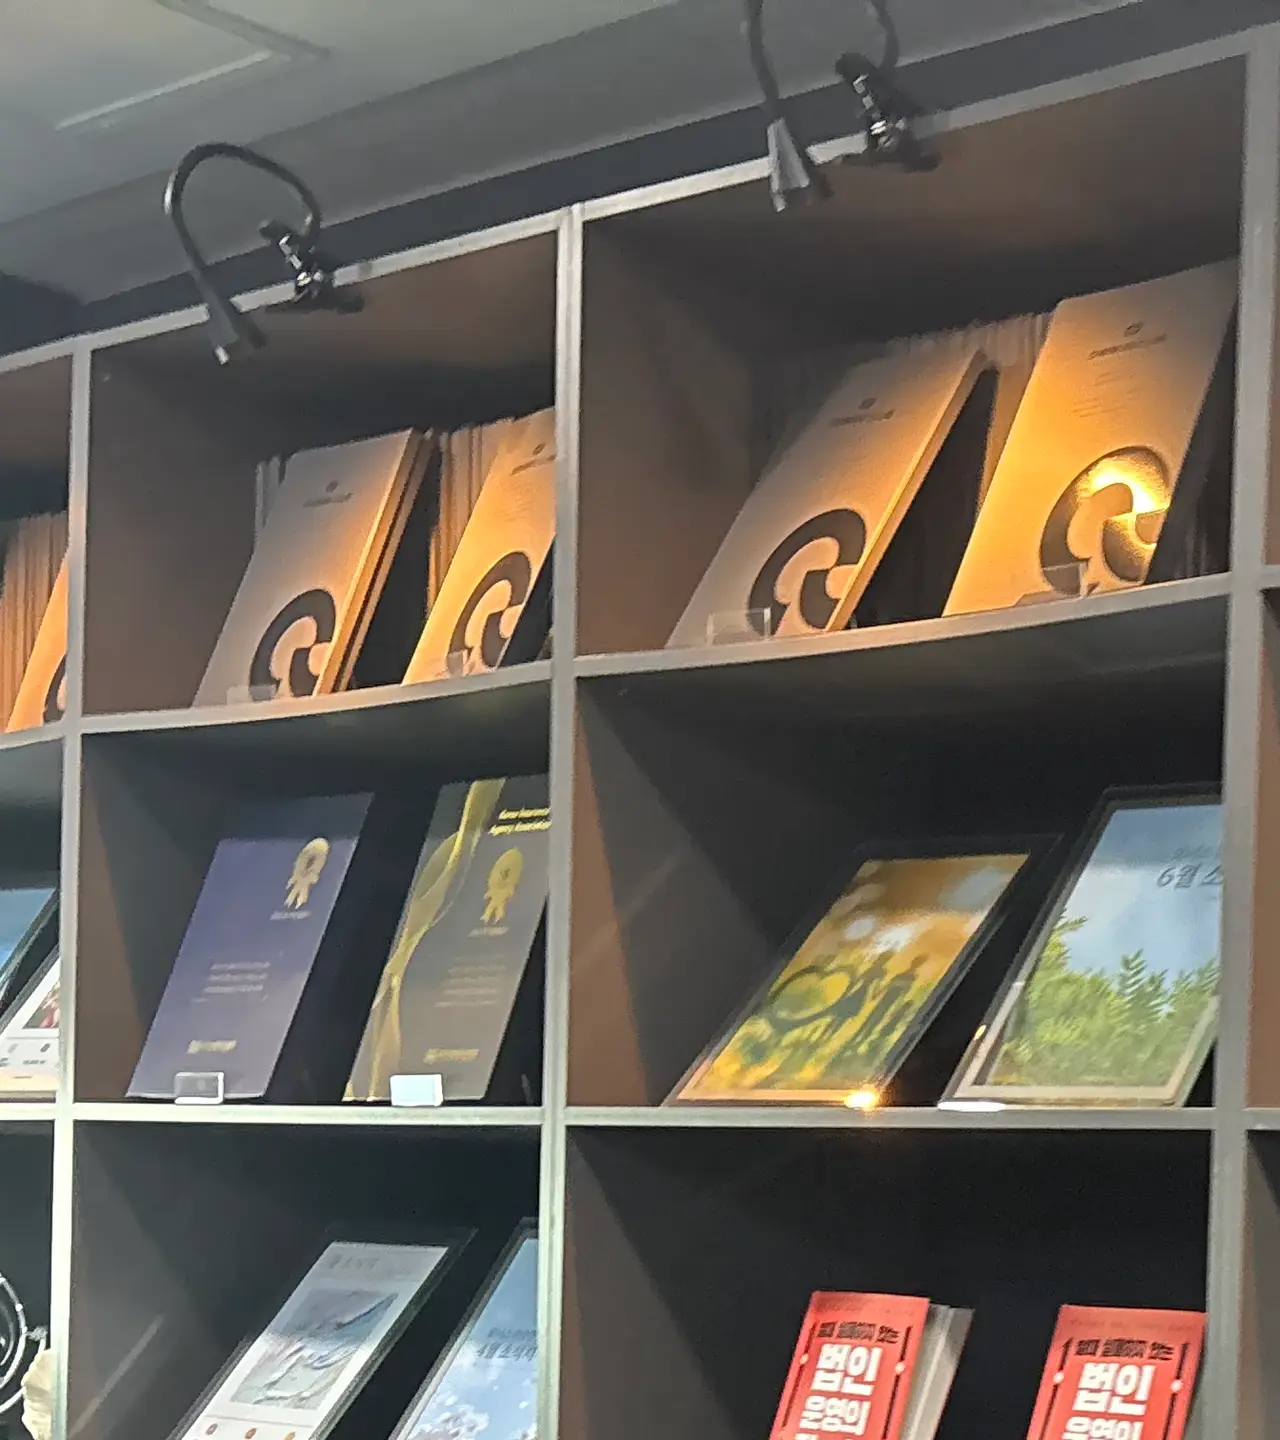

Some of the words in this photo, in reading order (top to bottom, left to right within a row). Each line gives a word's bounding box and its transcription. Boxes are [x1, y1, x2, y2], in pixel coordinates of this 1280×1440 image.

[1157, 862, 1202, 889] 6월
[811, 1343, 883, 1396] 법인
[1072, 1362, 1156, 1415] 법인
[799, 1395, 871, 1436] 운영의
